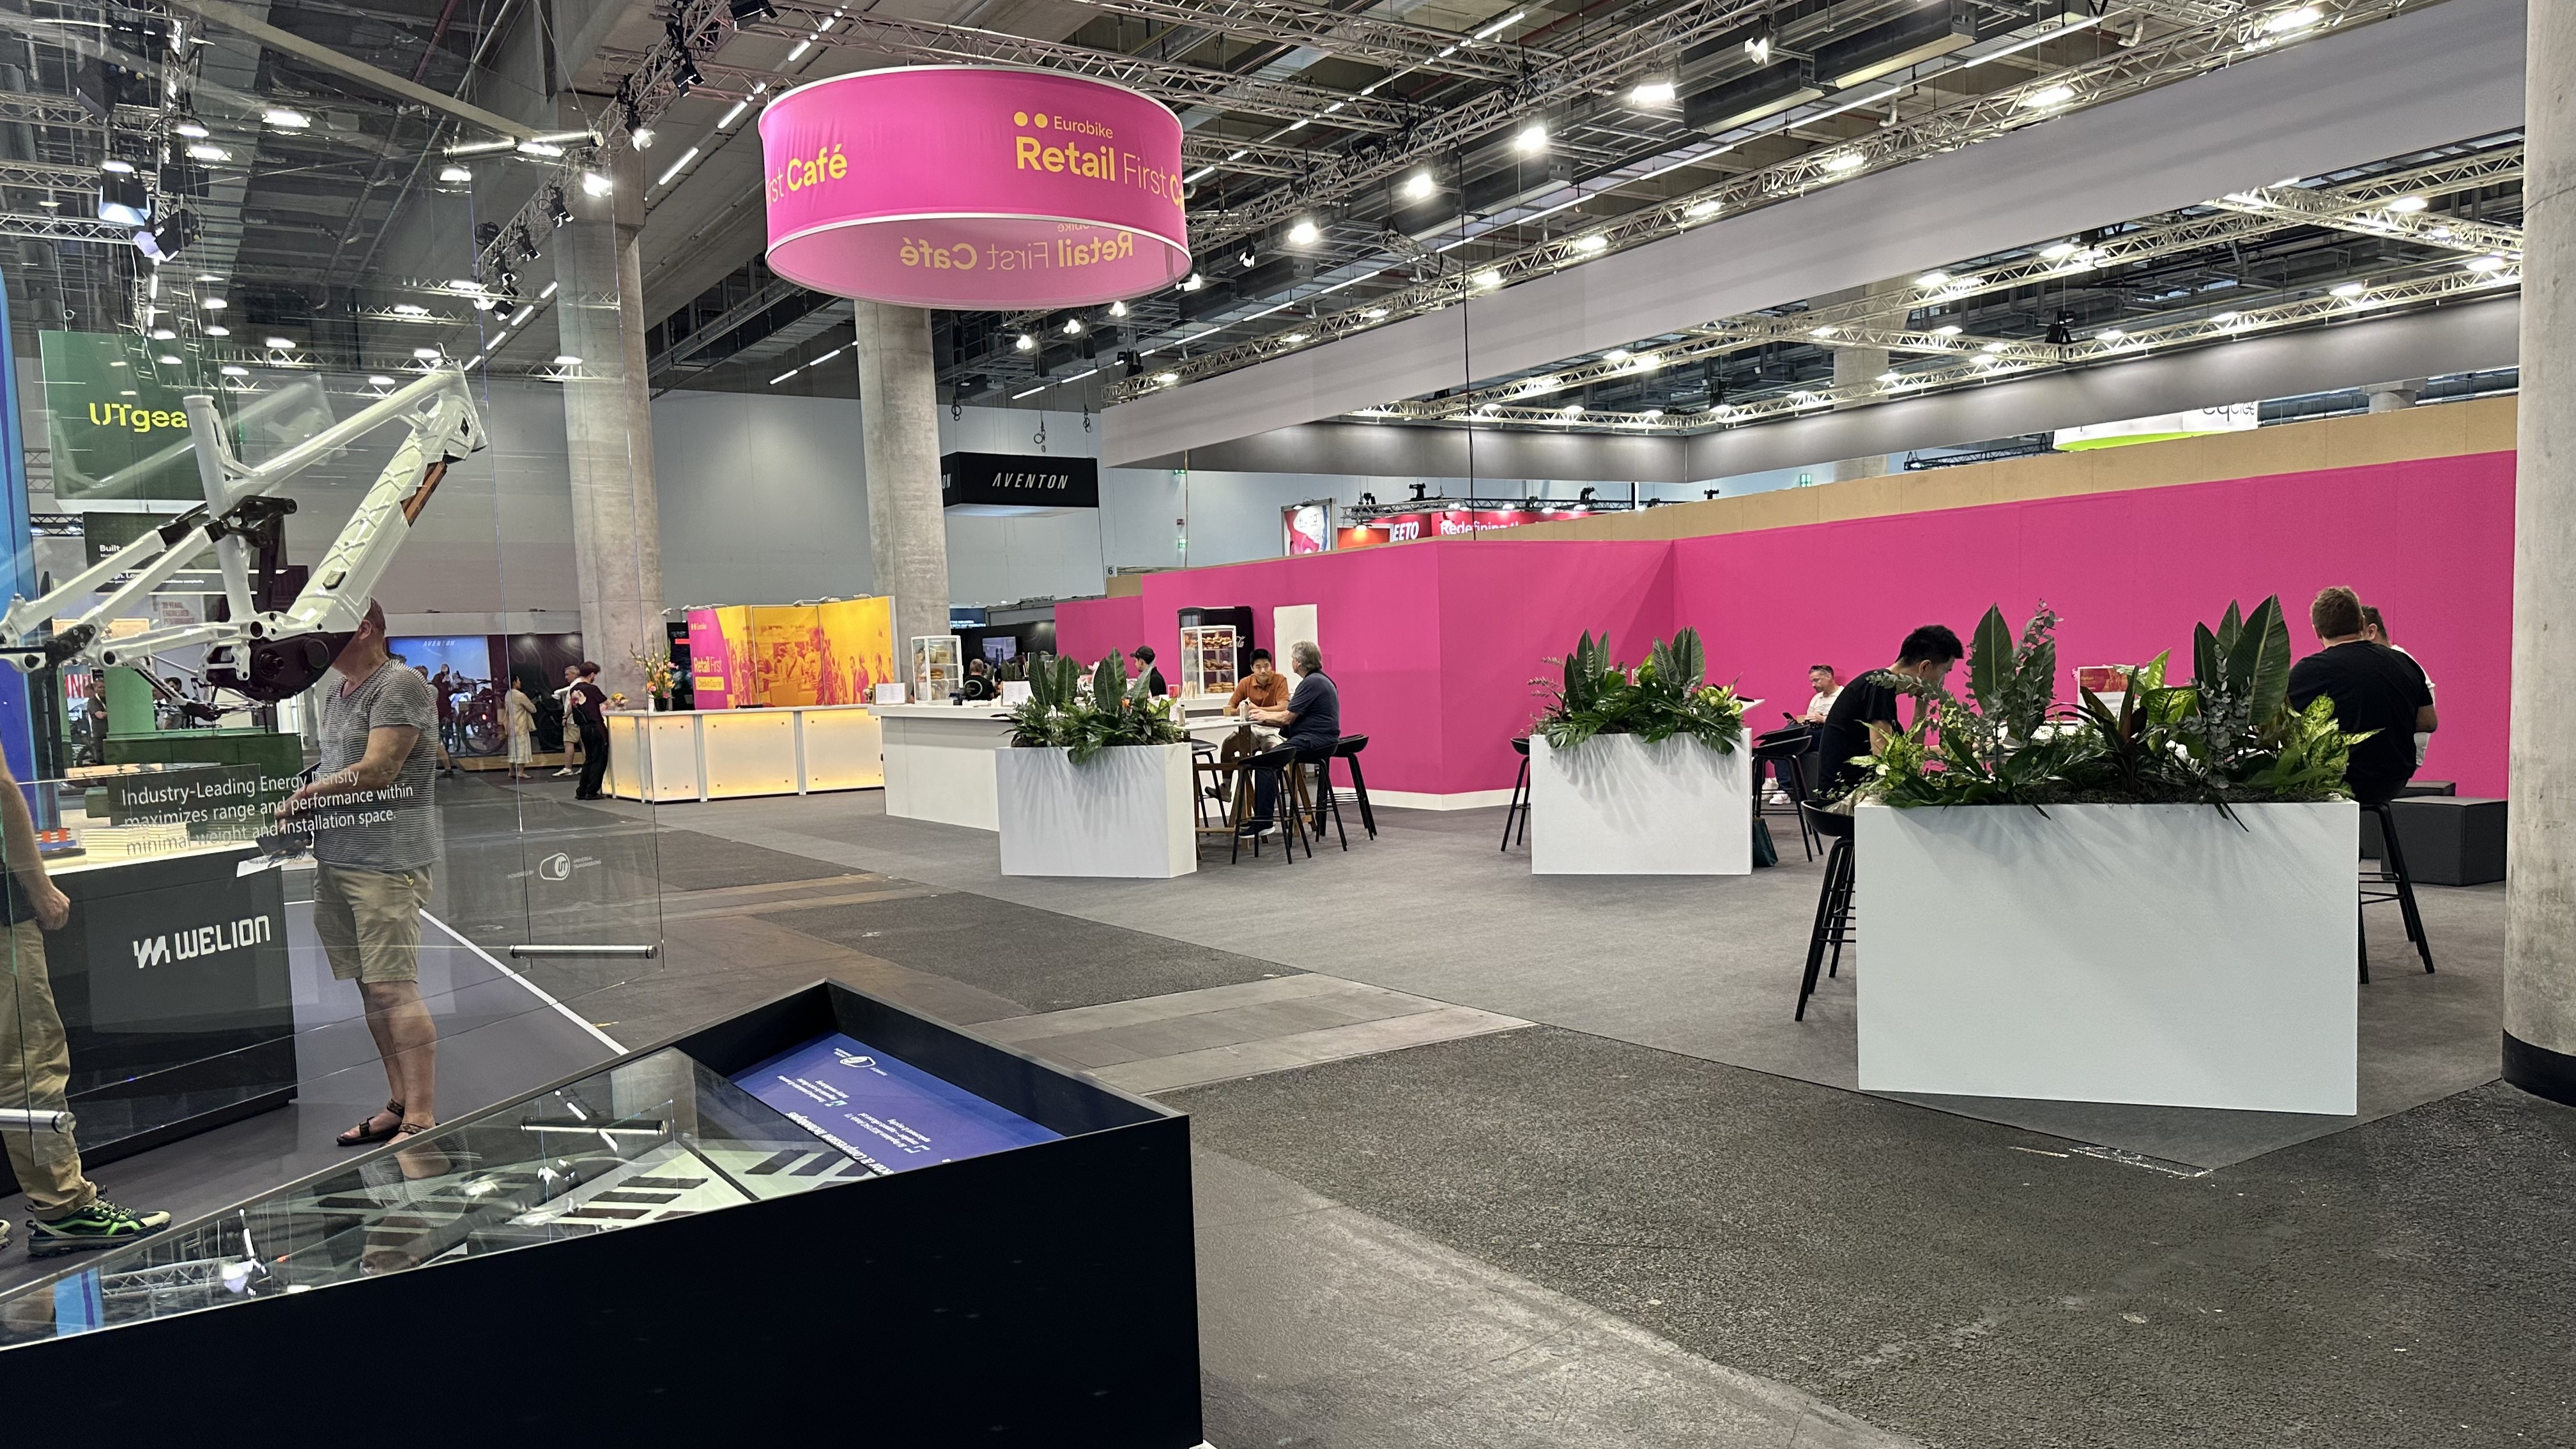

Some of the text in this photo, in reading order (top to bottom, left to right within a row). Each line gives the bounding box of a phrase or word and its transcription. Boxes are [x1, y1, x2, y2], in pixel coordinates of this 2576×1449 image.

[1054, 116, 1114, 139] Eurobike
[787, 143, 848, 192] Café
[1016, 136, 1185, 211] Retail First Ca
[89, 402, 188, 433] UTgea
[992, 472, 1068, 489] AVENTON
[1440, 520, 1507, 535] Redefin
[1108, 567, 1113, 575] 6
[121, 770, 360, 806] Industry-Leading Energy Density
[125, 784, 413, 830] maximizes range and performance within
[127, 809, 396, 855] minimal weight and installation space.
[174, 915, 271, 960] WELION
